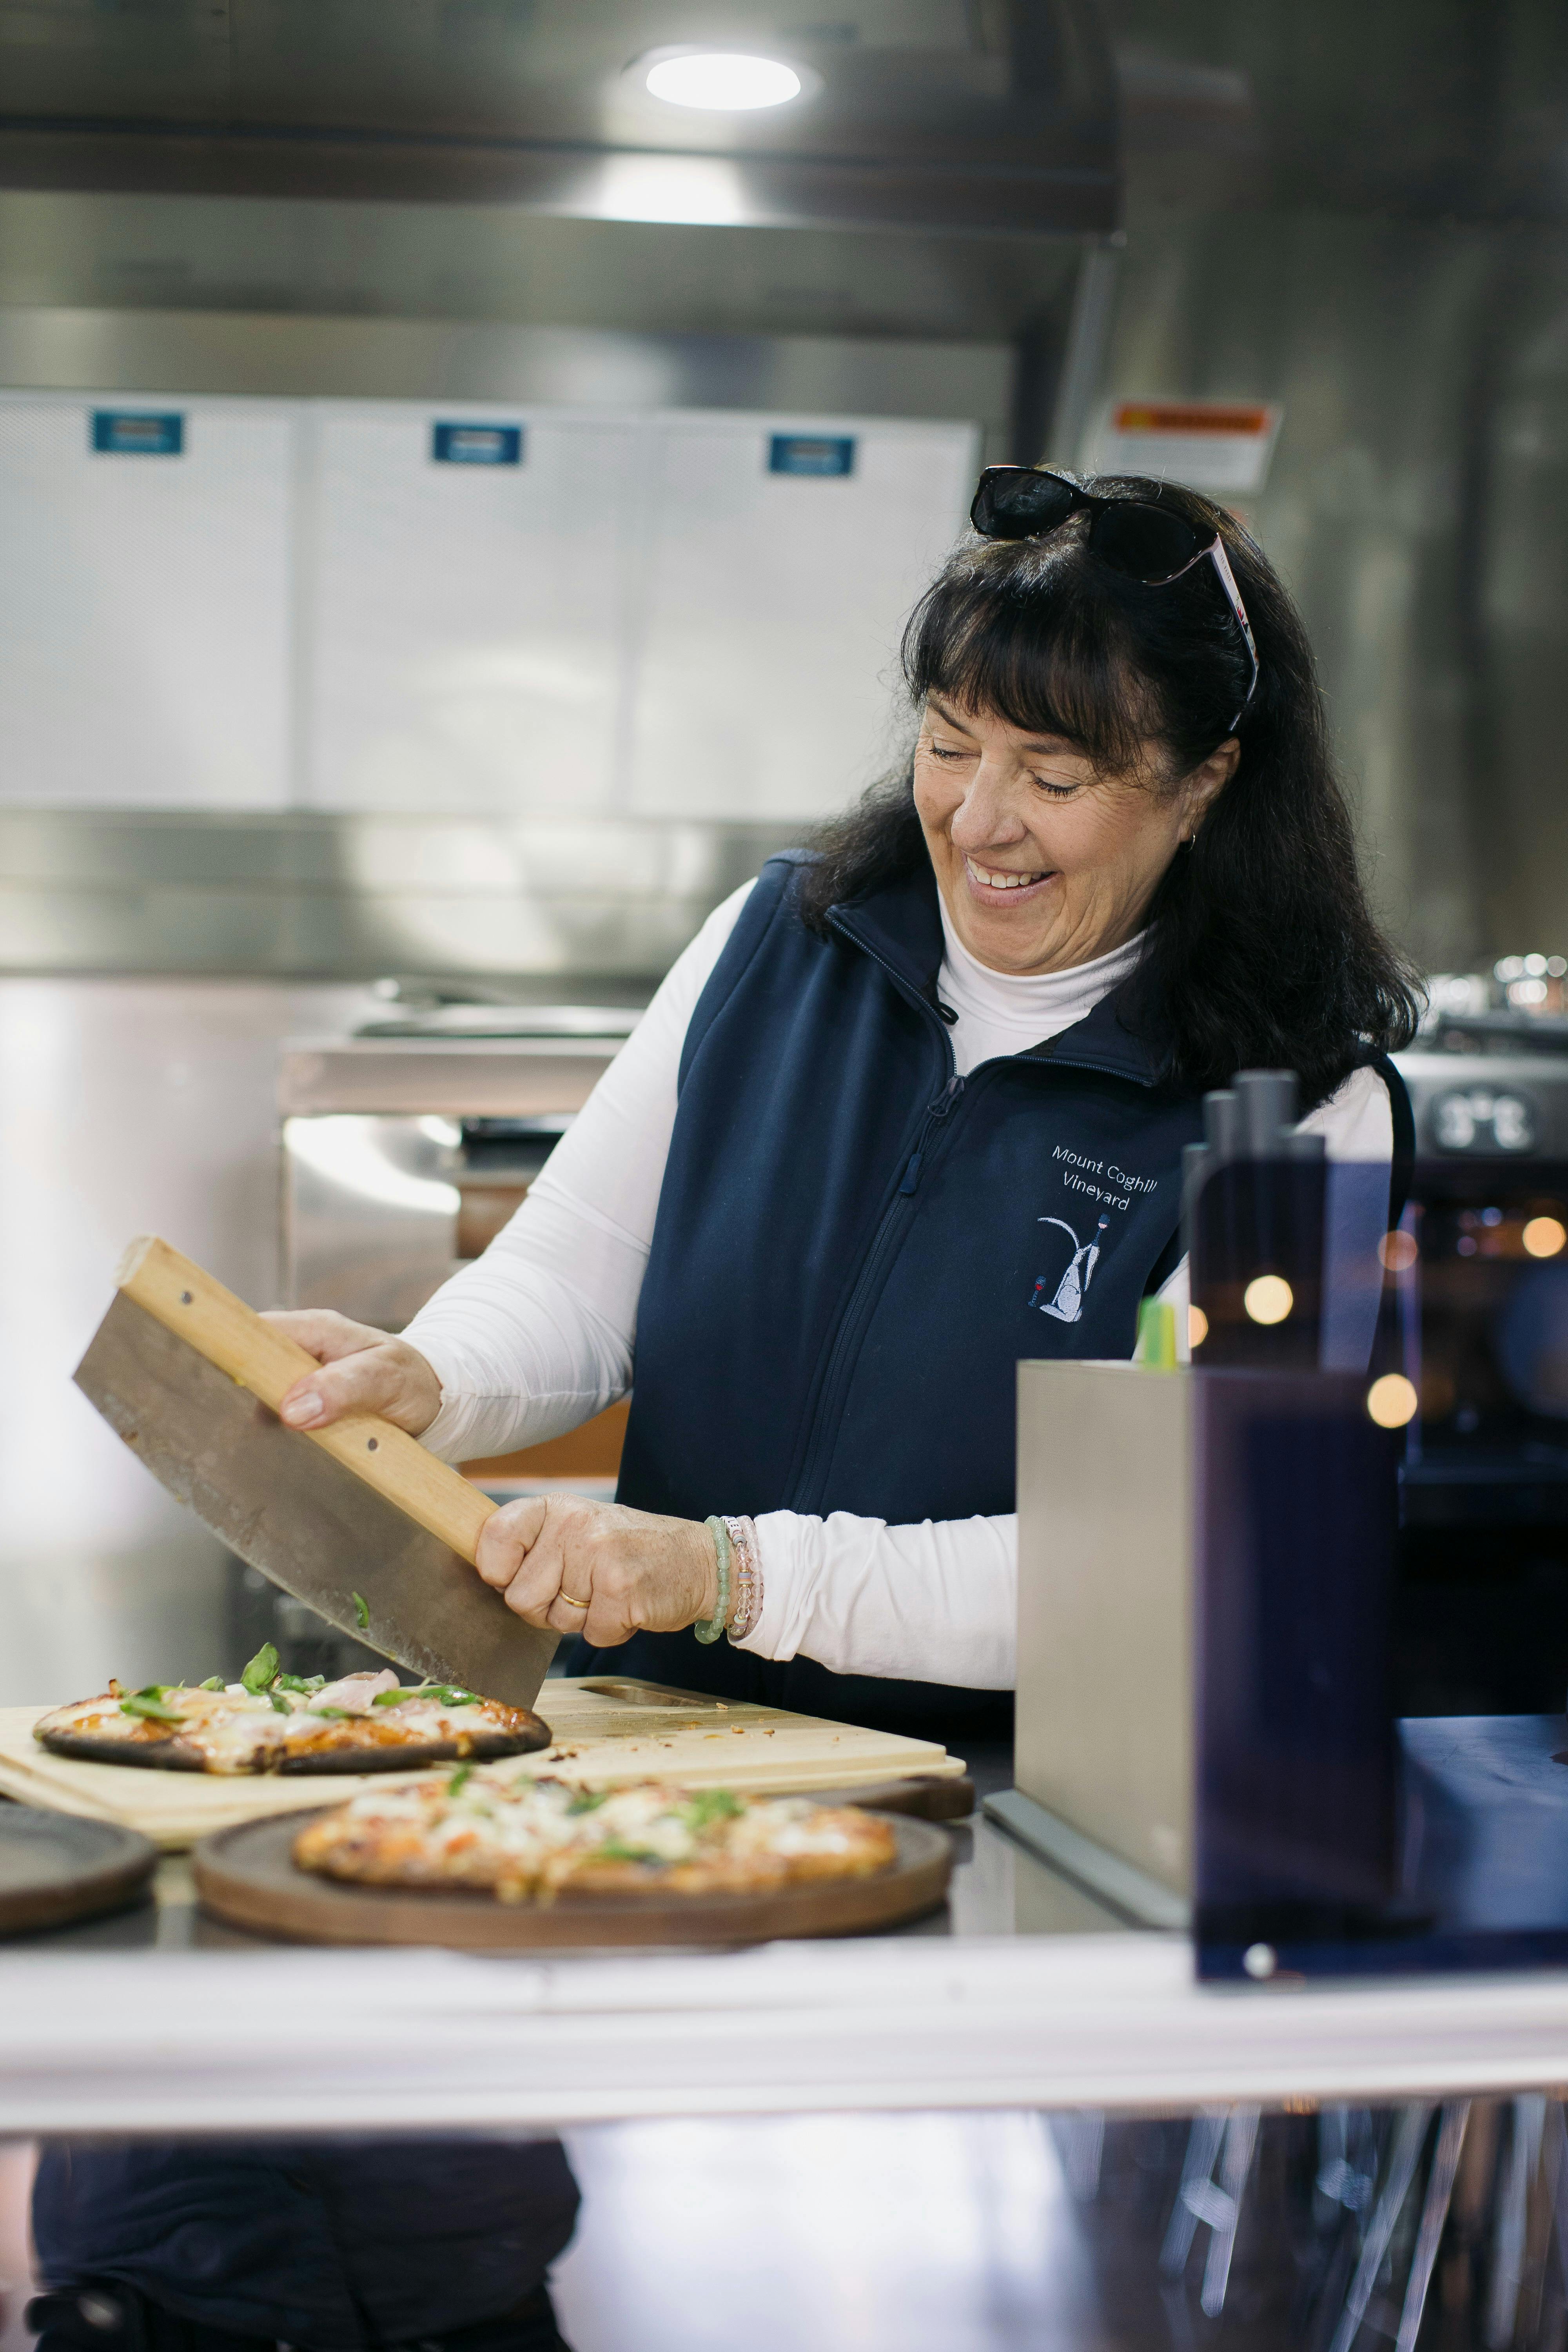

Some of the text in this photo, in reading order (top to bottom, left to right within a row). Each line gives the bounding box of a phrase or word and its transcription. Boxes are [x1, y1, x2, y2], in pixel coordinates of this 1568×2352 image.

[1052, 1145, 1157, 1193] Mount Coghill
[1064, 1171, 1130, 1210] Vineyard
